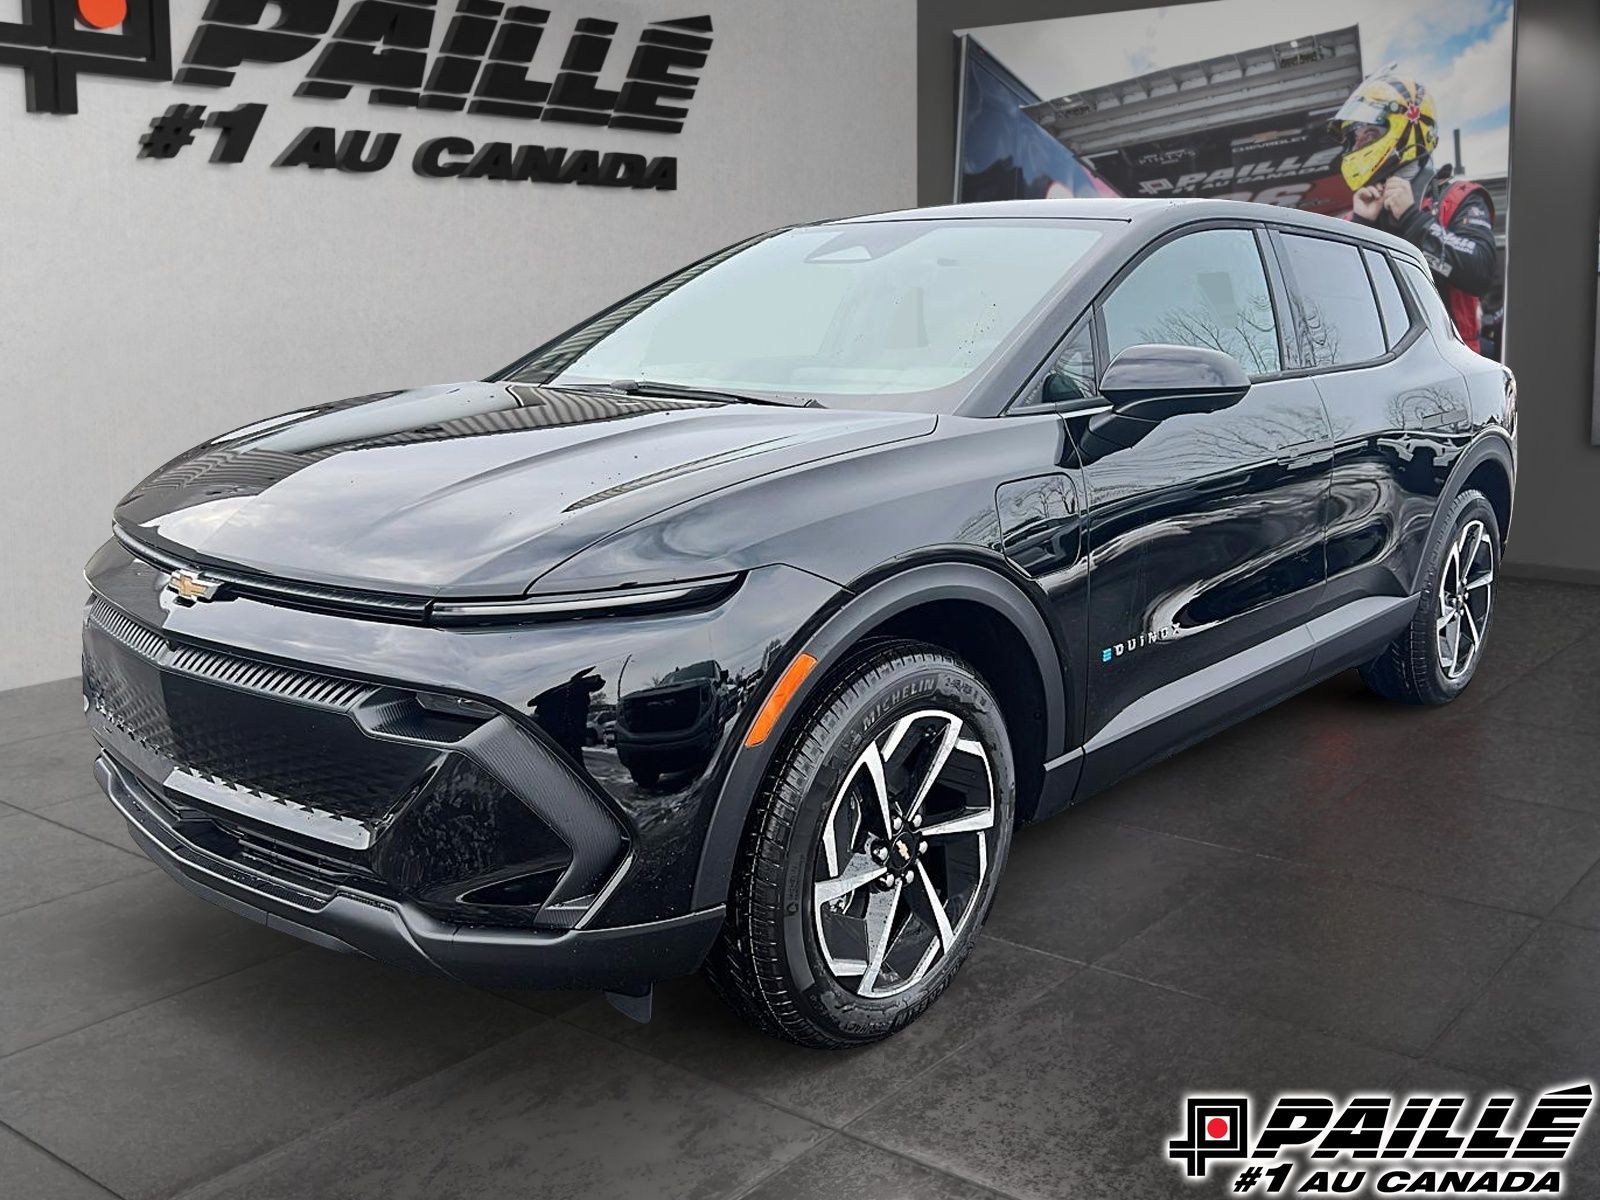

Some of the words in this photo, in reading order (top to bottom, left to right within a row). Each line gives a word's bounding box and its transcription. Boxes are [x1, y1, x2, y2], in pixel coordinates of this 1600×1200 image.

[172, 0, 713, 133] PAILLÉ
[137, 103, 267, 163] #1
[270, 127, 401, 172] AU
[412, 137, 677, 190] CANADA
[1201, 180, 1230, 190] AU
[1237, 165, 1330, 183] CANADA
[1102, 622, 1180, 662] EQUINOX
[862, 678, 935, 731] MICHELIN
